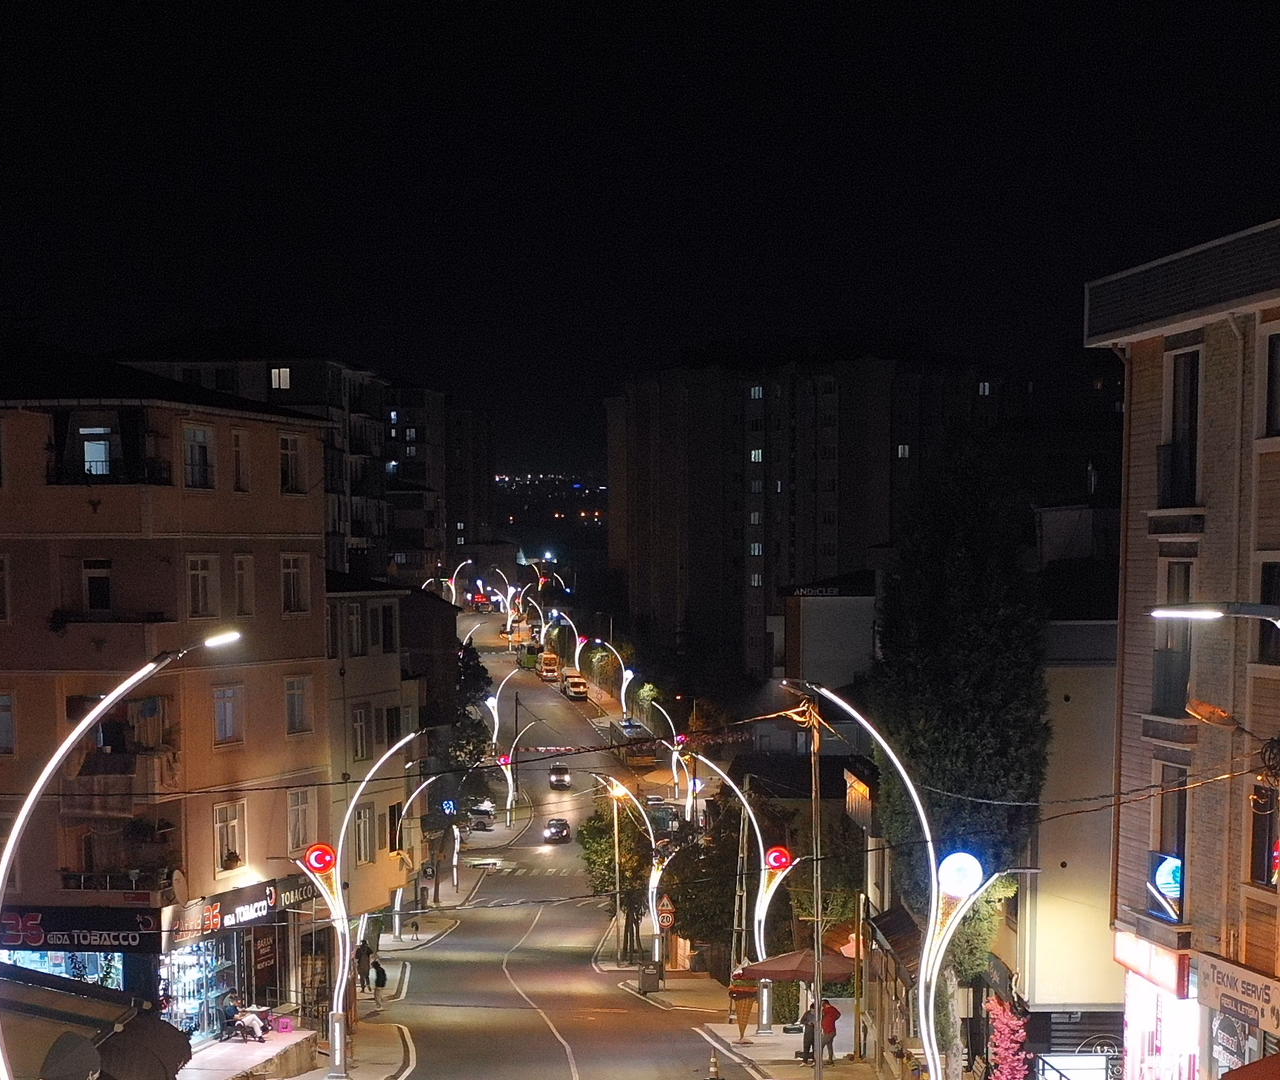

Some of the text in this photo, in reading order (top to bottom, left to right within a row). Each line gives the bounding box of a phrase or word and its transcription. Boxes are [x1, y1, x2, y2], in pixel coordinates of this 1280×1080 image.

[281, 885, 313, 906] TOBACCO
[1, 912, 45, 946] 36
[47, 933, 70, 945] GIDA
[71, 930, 140, 946] TOBACCO
[203, 902, 221, 935] 36
[235, 899, 268, 923] TOBACCO
[660, 915, 671, 924] 20
[1210, 963, 1271, 1005] TEKNİK SERVİS
